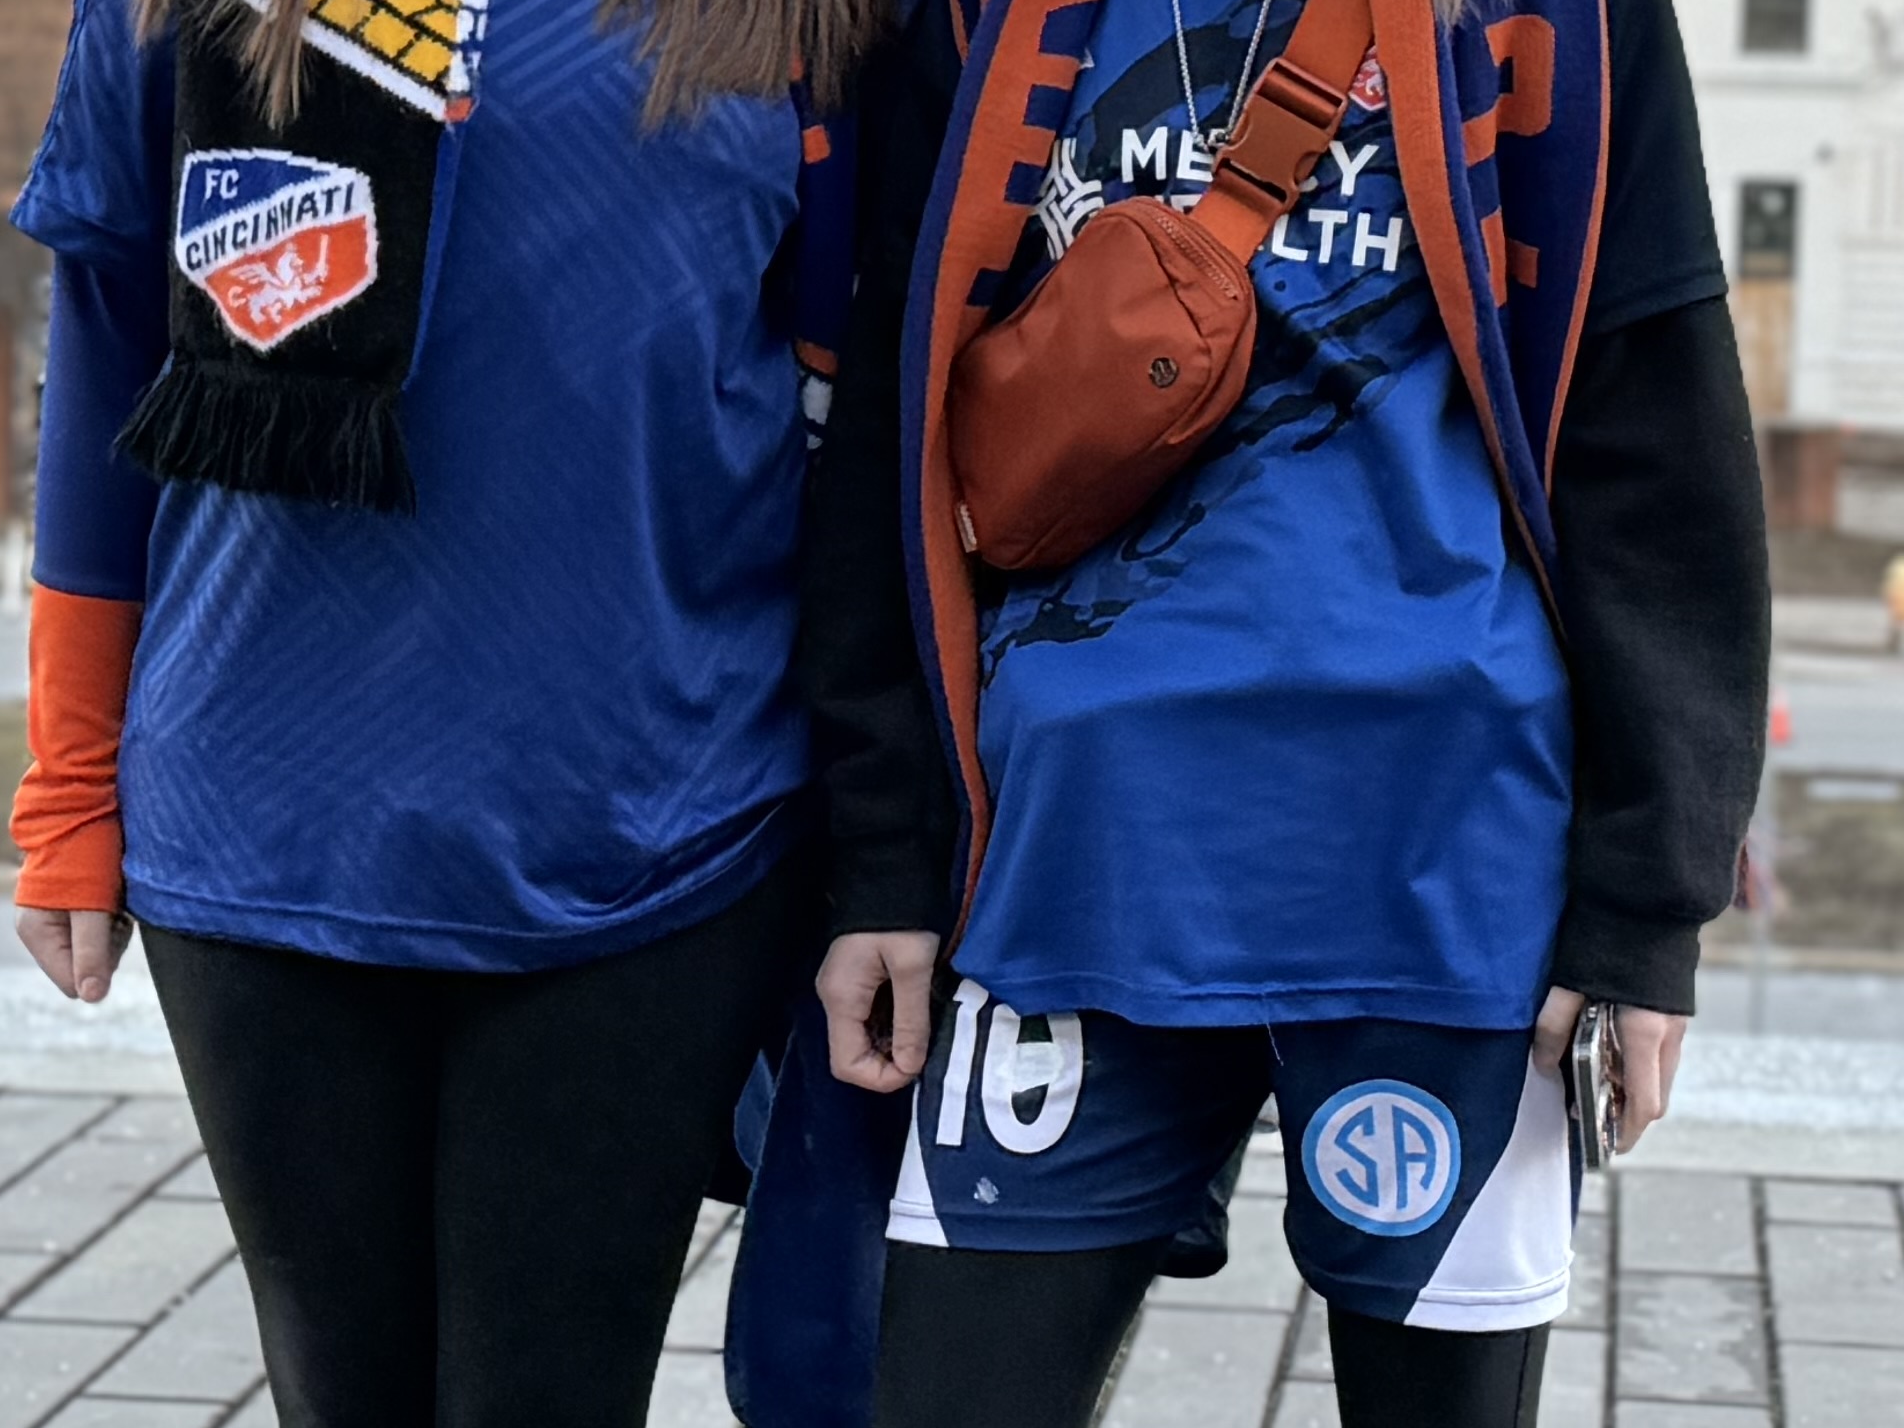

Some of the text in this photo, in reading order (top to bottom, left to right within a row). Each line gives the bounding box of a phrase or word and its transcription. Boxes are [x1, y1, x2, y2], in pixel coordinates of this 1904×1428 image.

[204, 168, 240, 200] FC
[1120, 125, 1380, 197] MEY
[185, 181, 355, 272] CINCINNATI
[1158, 192, 1403, 272] LTH
[1334, 1103, 1437, 1210] SA
